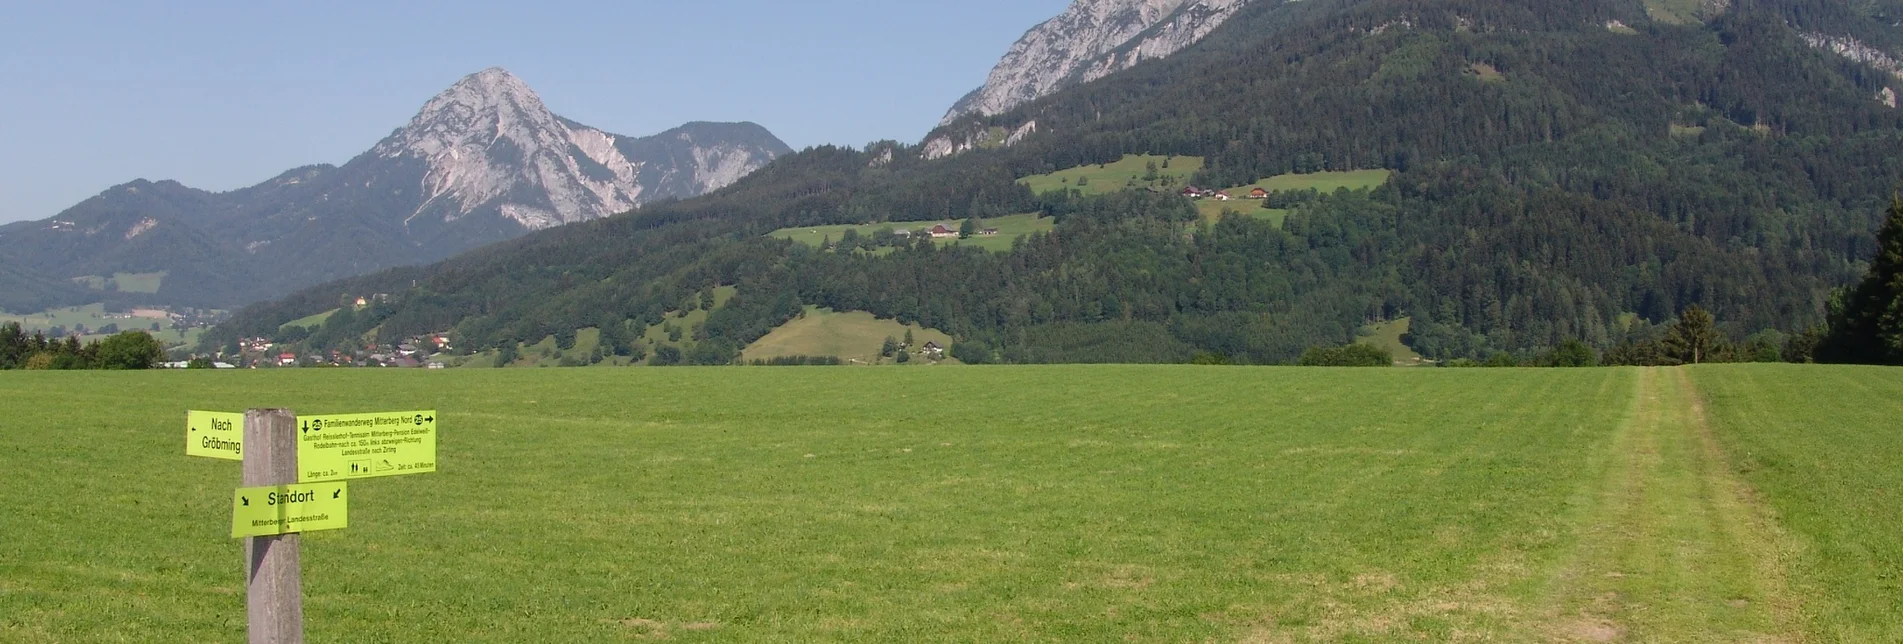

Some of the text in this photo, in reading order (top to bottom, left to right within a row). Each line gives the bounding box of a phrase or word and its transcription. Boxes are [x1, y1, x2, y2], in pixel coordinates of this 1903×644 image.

[211, 418, 232, 431] Nach
[324, 418, 373, 428] Familienwanderweg
[374, 416, 399, 426] Mitterberg
[401, 416, 412, 424] Nord
[371, 429, 410, 438] Mitterberg-Pension
[202, 436, 241, 453] Gröbming
[342, 448, 370, 456] Landesstraße
[268, 490, 314, 506] Standort
[252, 514, 329, 527] Mitterberger Landesstraße
